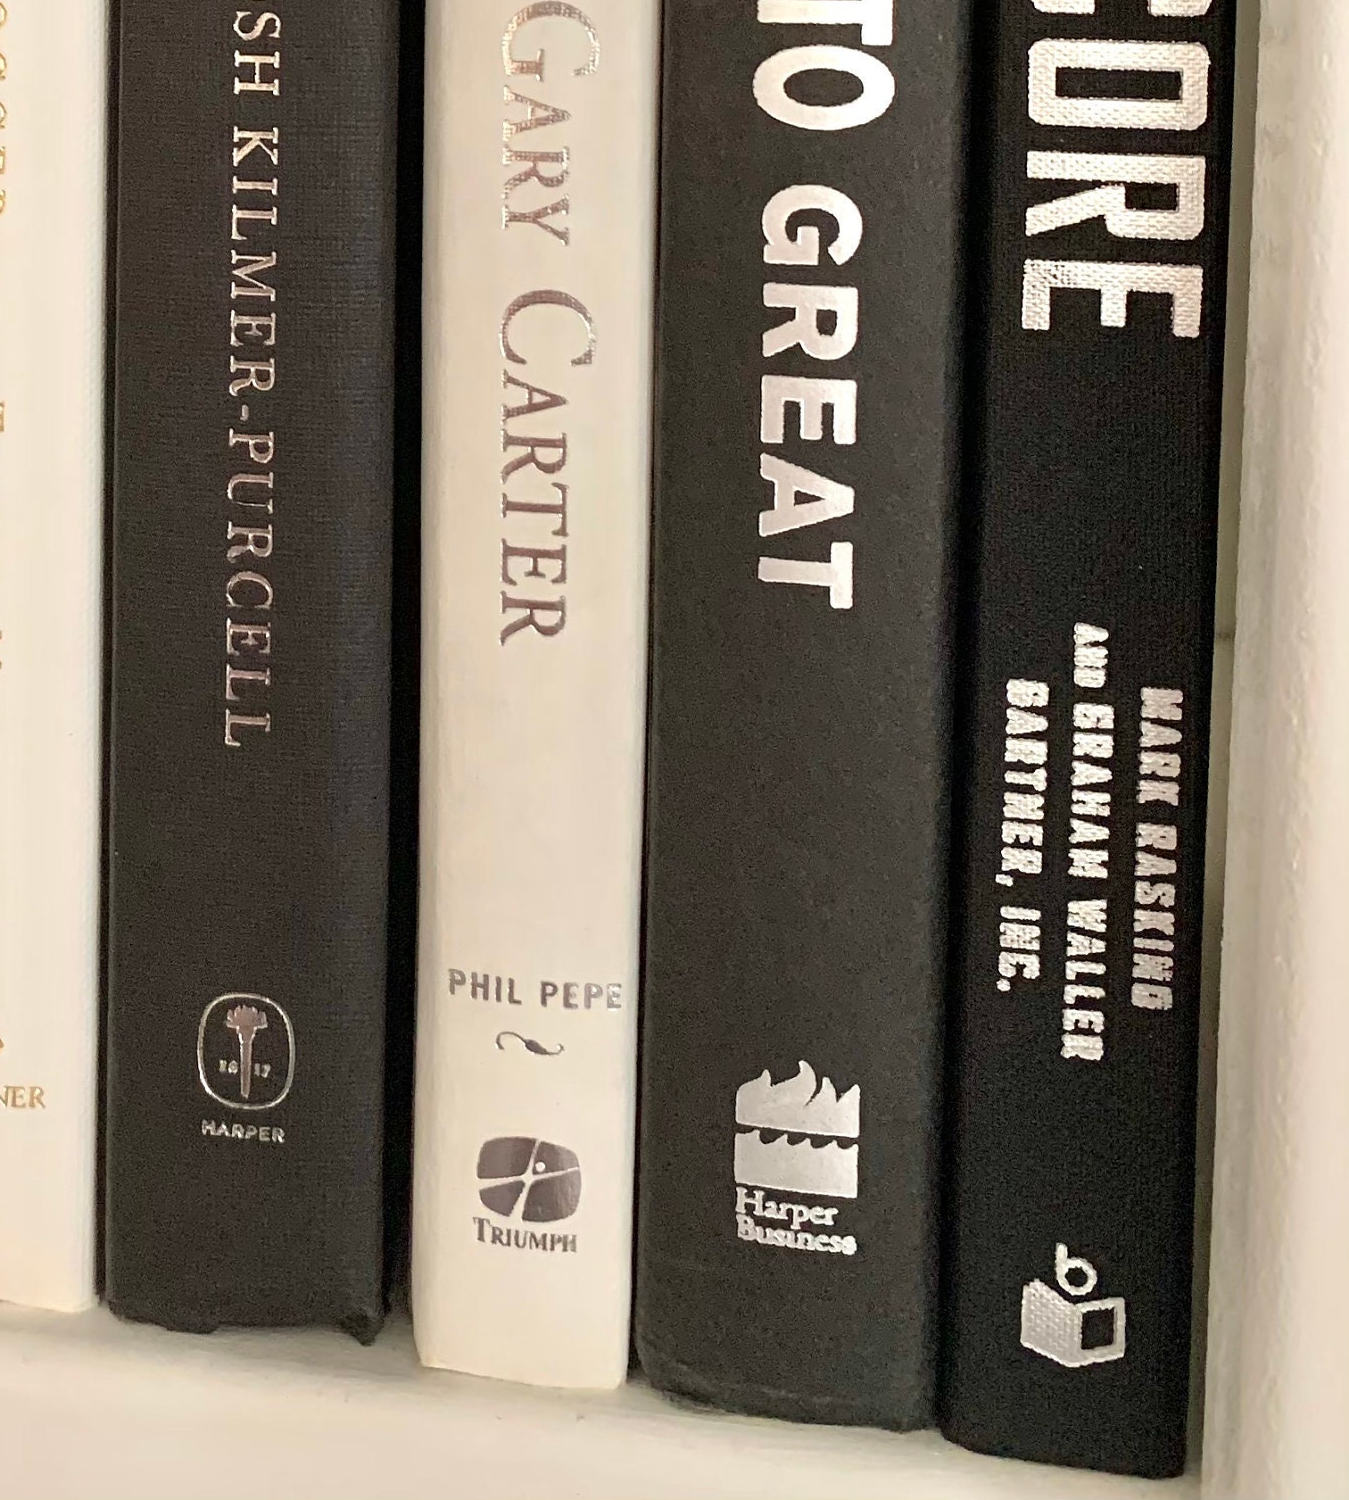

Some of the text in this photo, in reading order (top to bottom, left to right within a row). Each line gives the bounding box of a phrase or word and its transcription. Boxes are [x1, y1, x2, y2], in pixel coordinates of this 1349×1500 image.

[498, 0, 601, 646] GARY CARTER
[223, 126, 280, 747] KILMER-PURCELL
[757, 184, 864, 609] GREAT
[1138, 687, 1184, 805] MARK
[996, 678, 1050, 992] GARTNER, INC.
[1060, 622, 1114, 1061] AND GRAHAM WALLER
[448, 969, 623, 1010] PHIL PEPE
[201, 1119, 285, 1143] HARPER
[472, 1216, 578, 1254] TRIUMPH
[735, 1187, 839, 1230] Harper
[735, 1213, 858, 1256] Business
